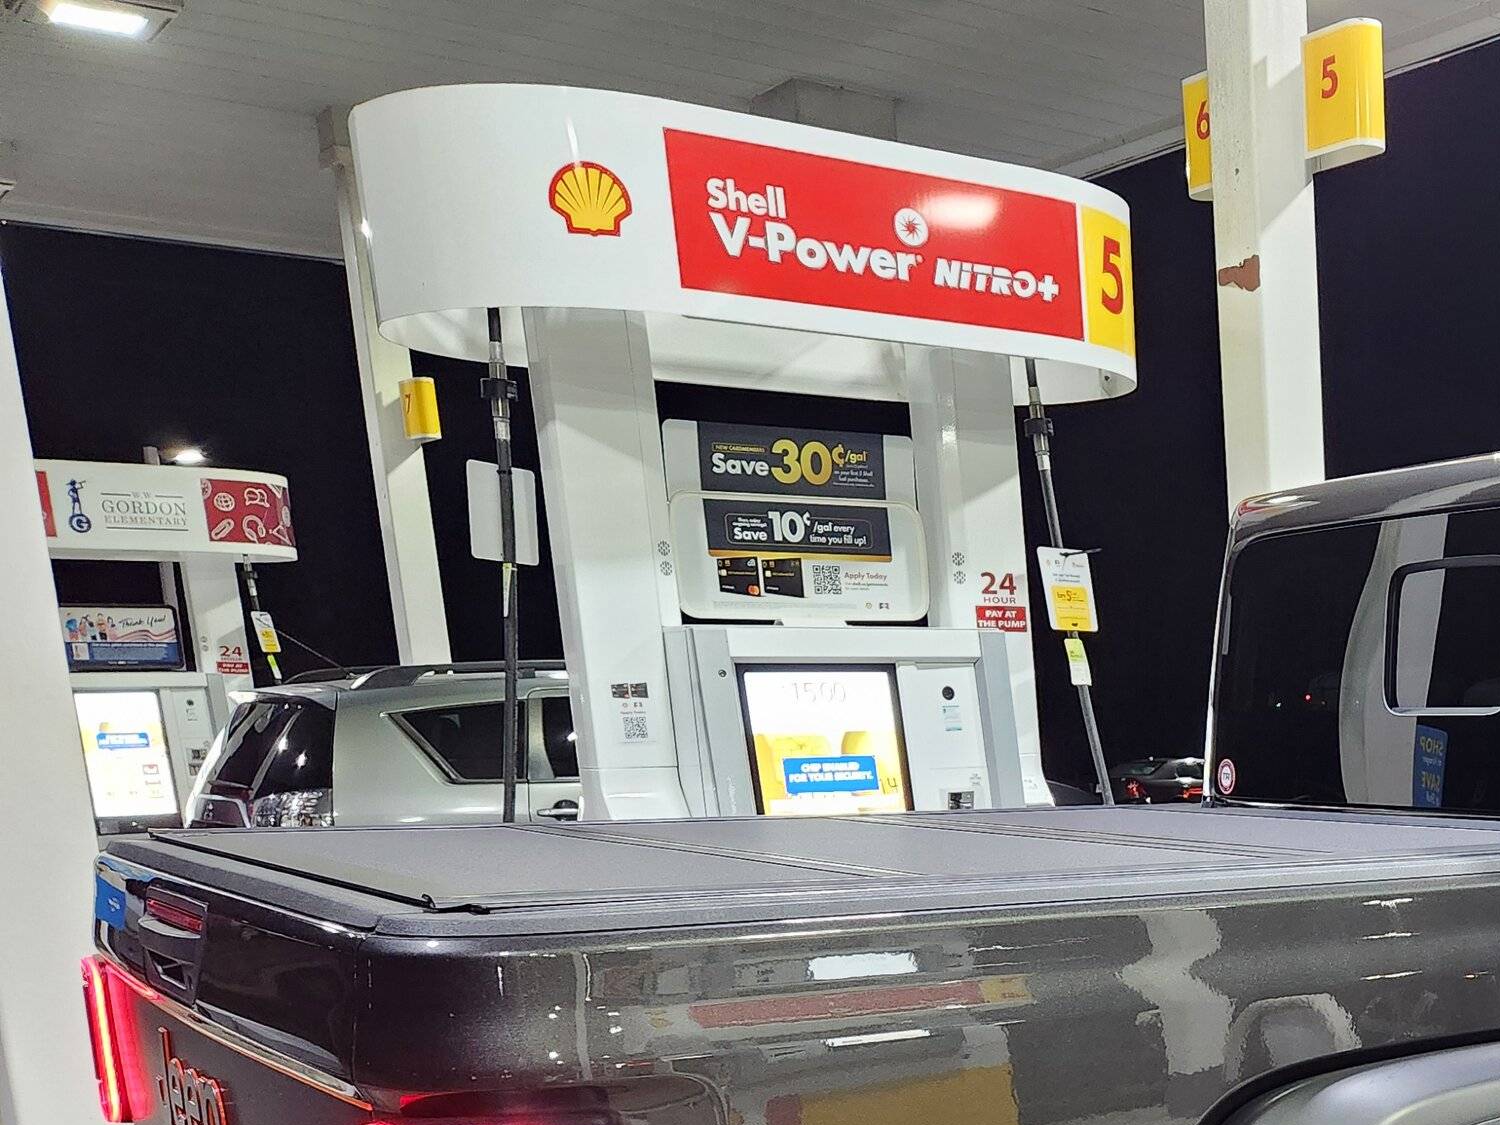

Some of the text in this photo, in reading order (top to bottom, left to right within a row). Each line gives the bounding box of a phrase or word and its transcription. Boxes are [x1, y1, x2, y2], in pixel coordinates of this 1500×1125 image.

[1321, 55, 1338, 99] 5
[1196, 100, 1211, 140] 6
[707, 178, 788, 219] Shell
[709, 211, 920, 282] V-Power
[1101, 236, 1125, 315] 5
[712, 452, 769, 477] Save
[101, 499, 187, 516] GORDON
[104, 516, 188, 527] ELEMENTARY
[734, 511, 811, 543] Save 10¢
[833, 524, 855, 535] every
[810, 534, 826, 544] time
[828, 535, 843, 546] you
[843, 534, 853, 544] fill
[844, 572, 887, 582] Apply Today
[981, 572, 1016, 595] 24
[984, 596, 1016, 604] HOUR
[219, 646, 242, 656] 24
